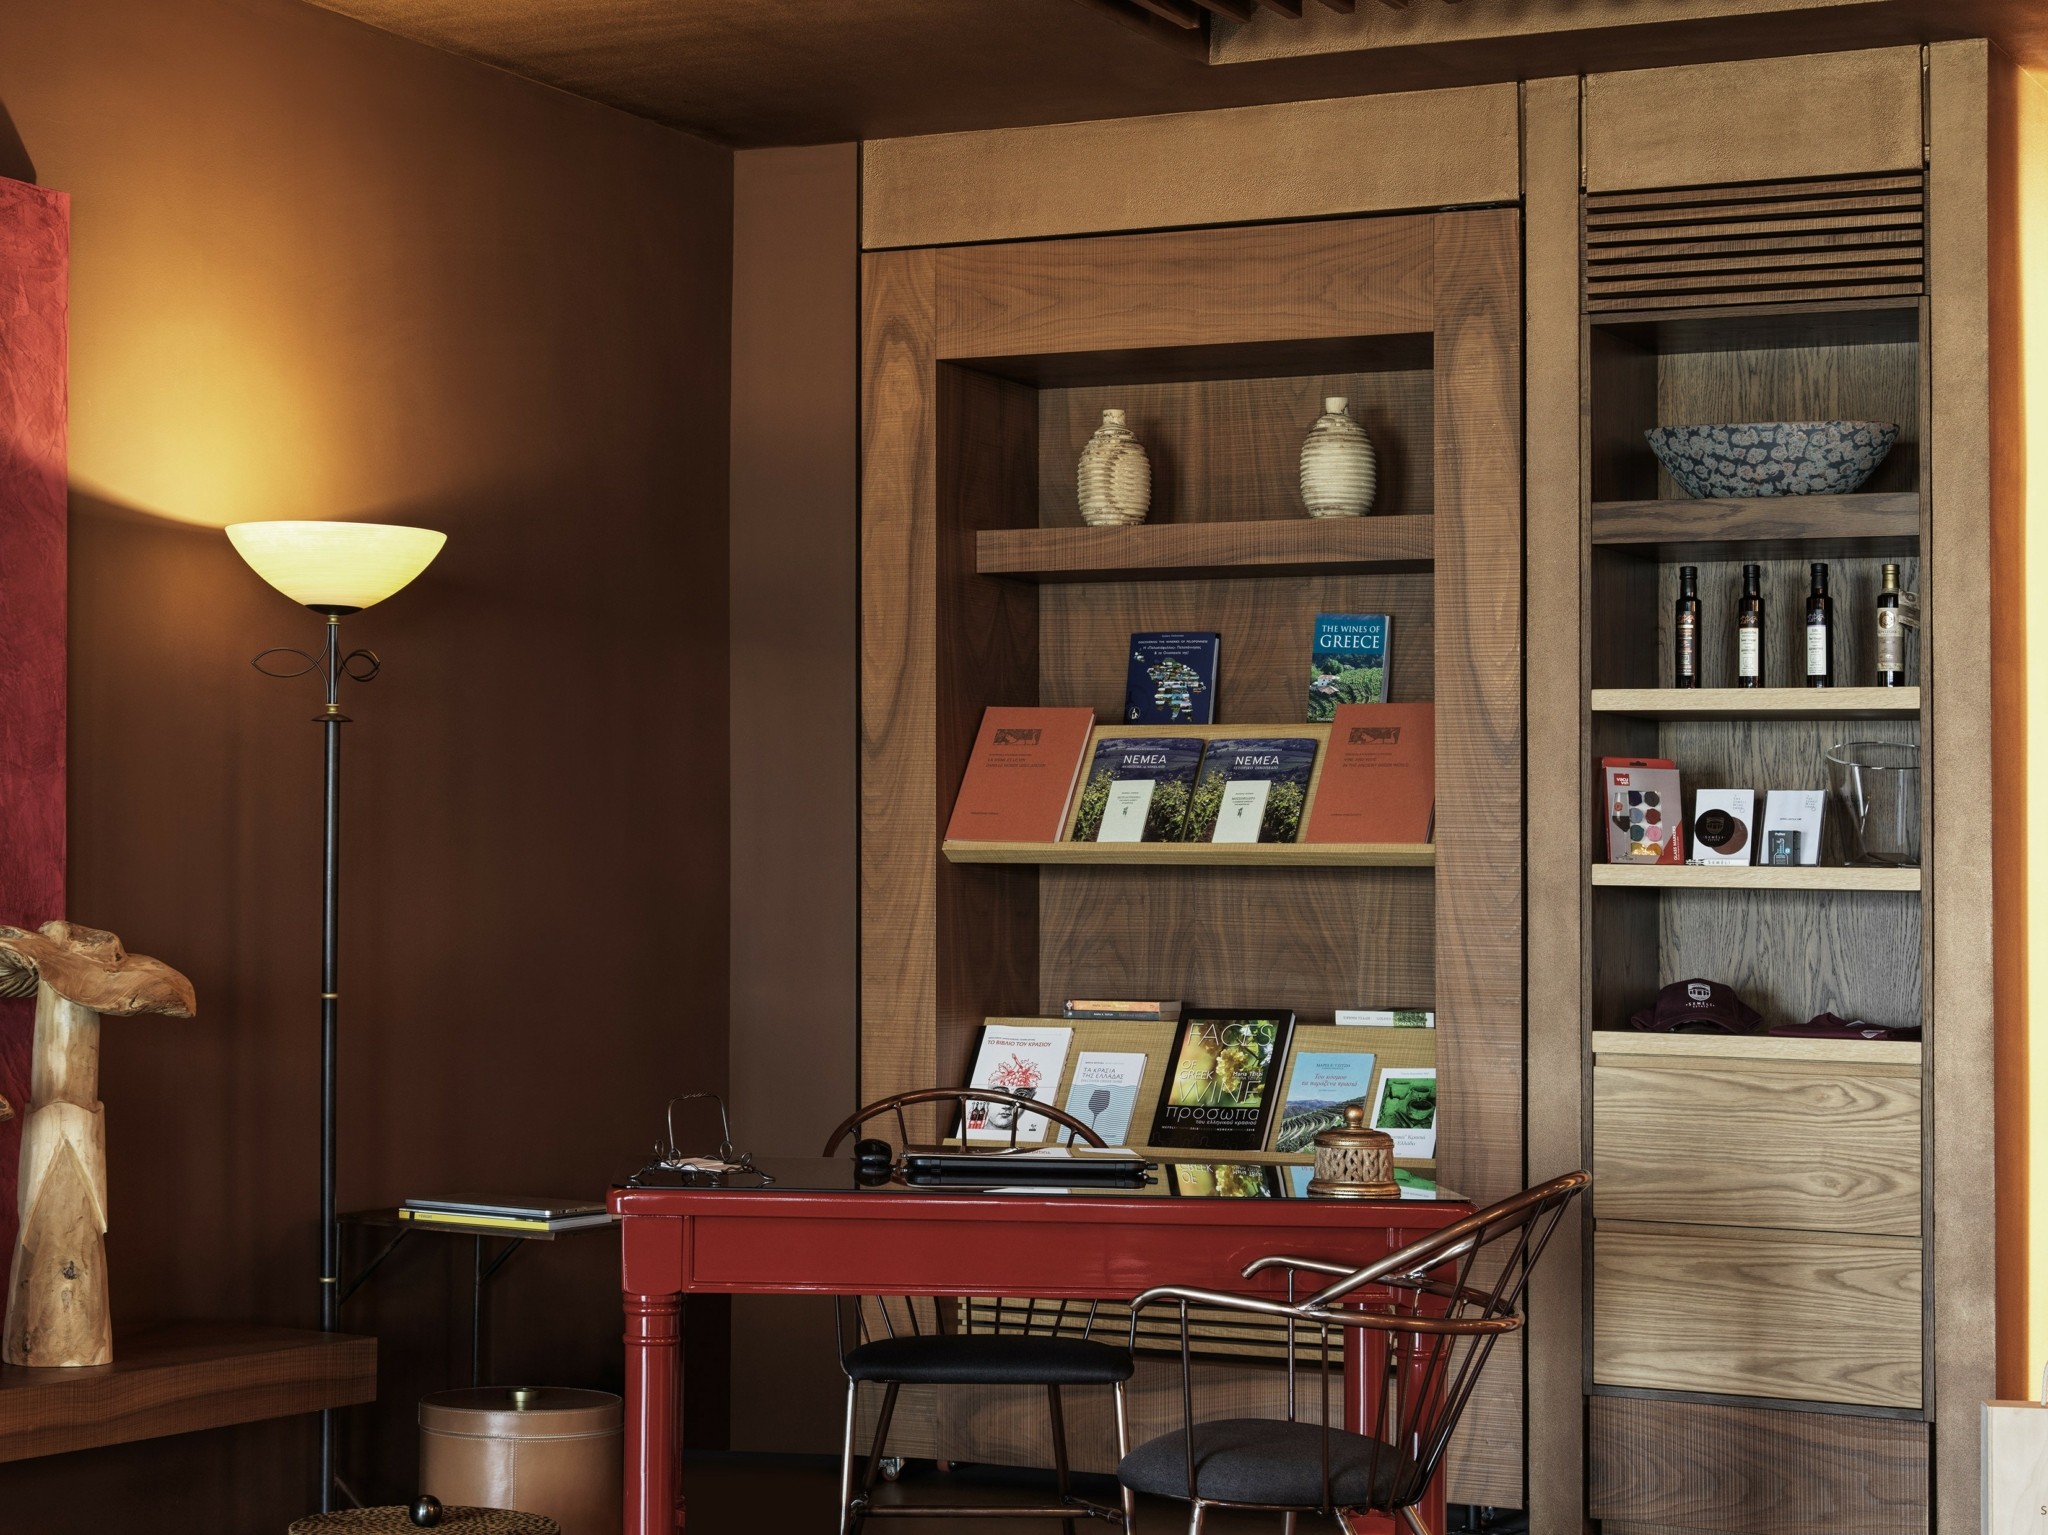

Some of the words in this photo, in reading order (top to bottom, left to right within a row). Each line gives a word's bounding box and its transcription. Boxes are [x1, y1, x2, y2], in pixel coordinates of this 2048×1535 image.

[1322, 625, 1339, 633] THE
[1341, 625, 1368, 633] WINES
[1369, 625, 1380, 633] OF
[1320, 634, 1380, 649] GREECE
[1123, 754, 1167, 764] NEMEA
[1187, 1023, 1273, 1047] FACES
[1181, 1059, 1198, 1070] OF
[1180, 1070, 1214, 1080] GREEK
[1179, 1080, 1262, 1104] WINE
[1166, 1103, 1260, 1122] πρόσωπα
